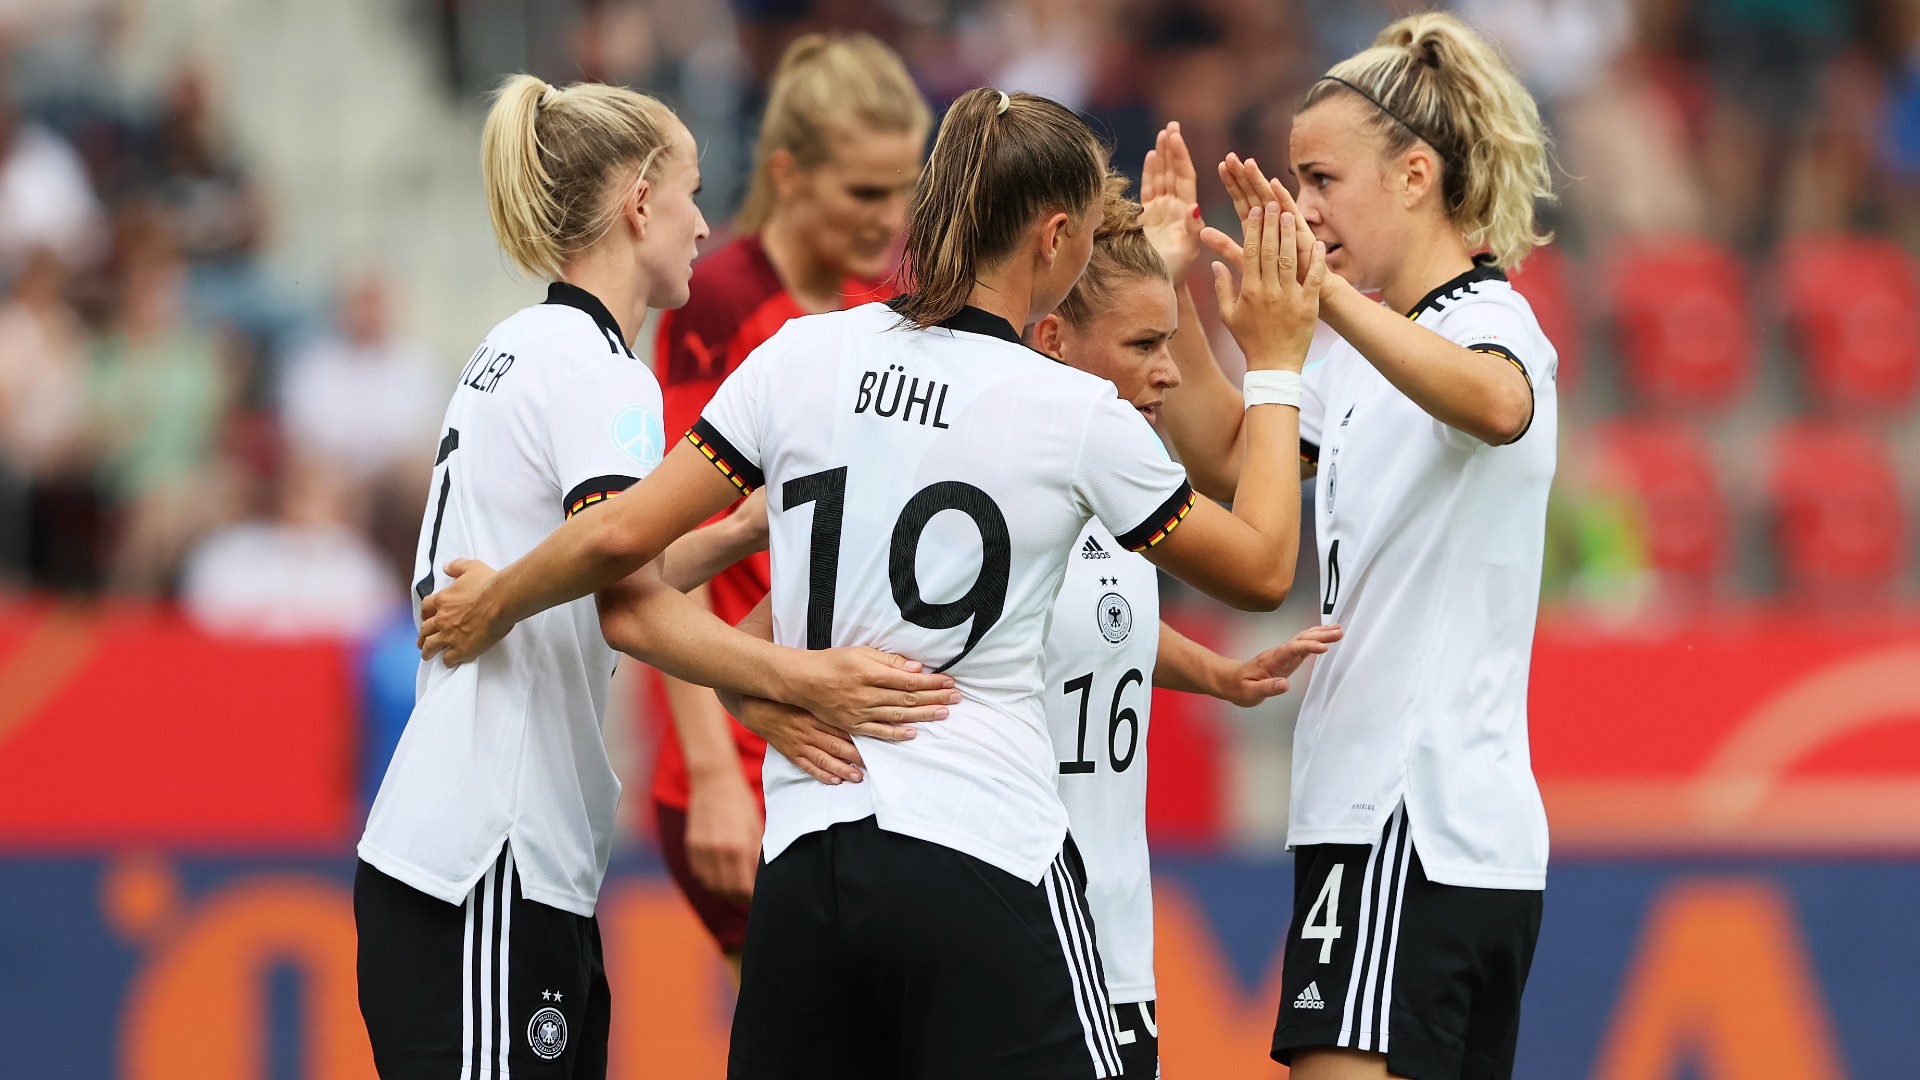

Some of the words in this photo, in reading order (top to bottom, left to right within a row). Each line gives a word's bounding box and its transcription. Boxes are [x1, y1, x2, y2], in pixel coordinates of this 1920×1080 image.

[854, 363, 949, 430] BÜHL
[782, 465, 1012, 674] 19
[1081, 550, 1111, 560] adidas
[1059, 668, 1144, 775] 16
[1301, 863, 1345, 964] 4
[1293, 998, 1325, 1010] adidas
